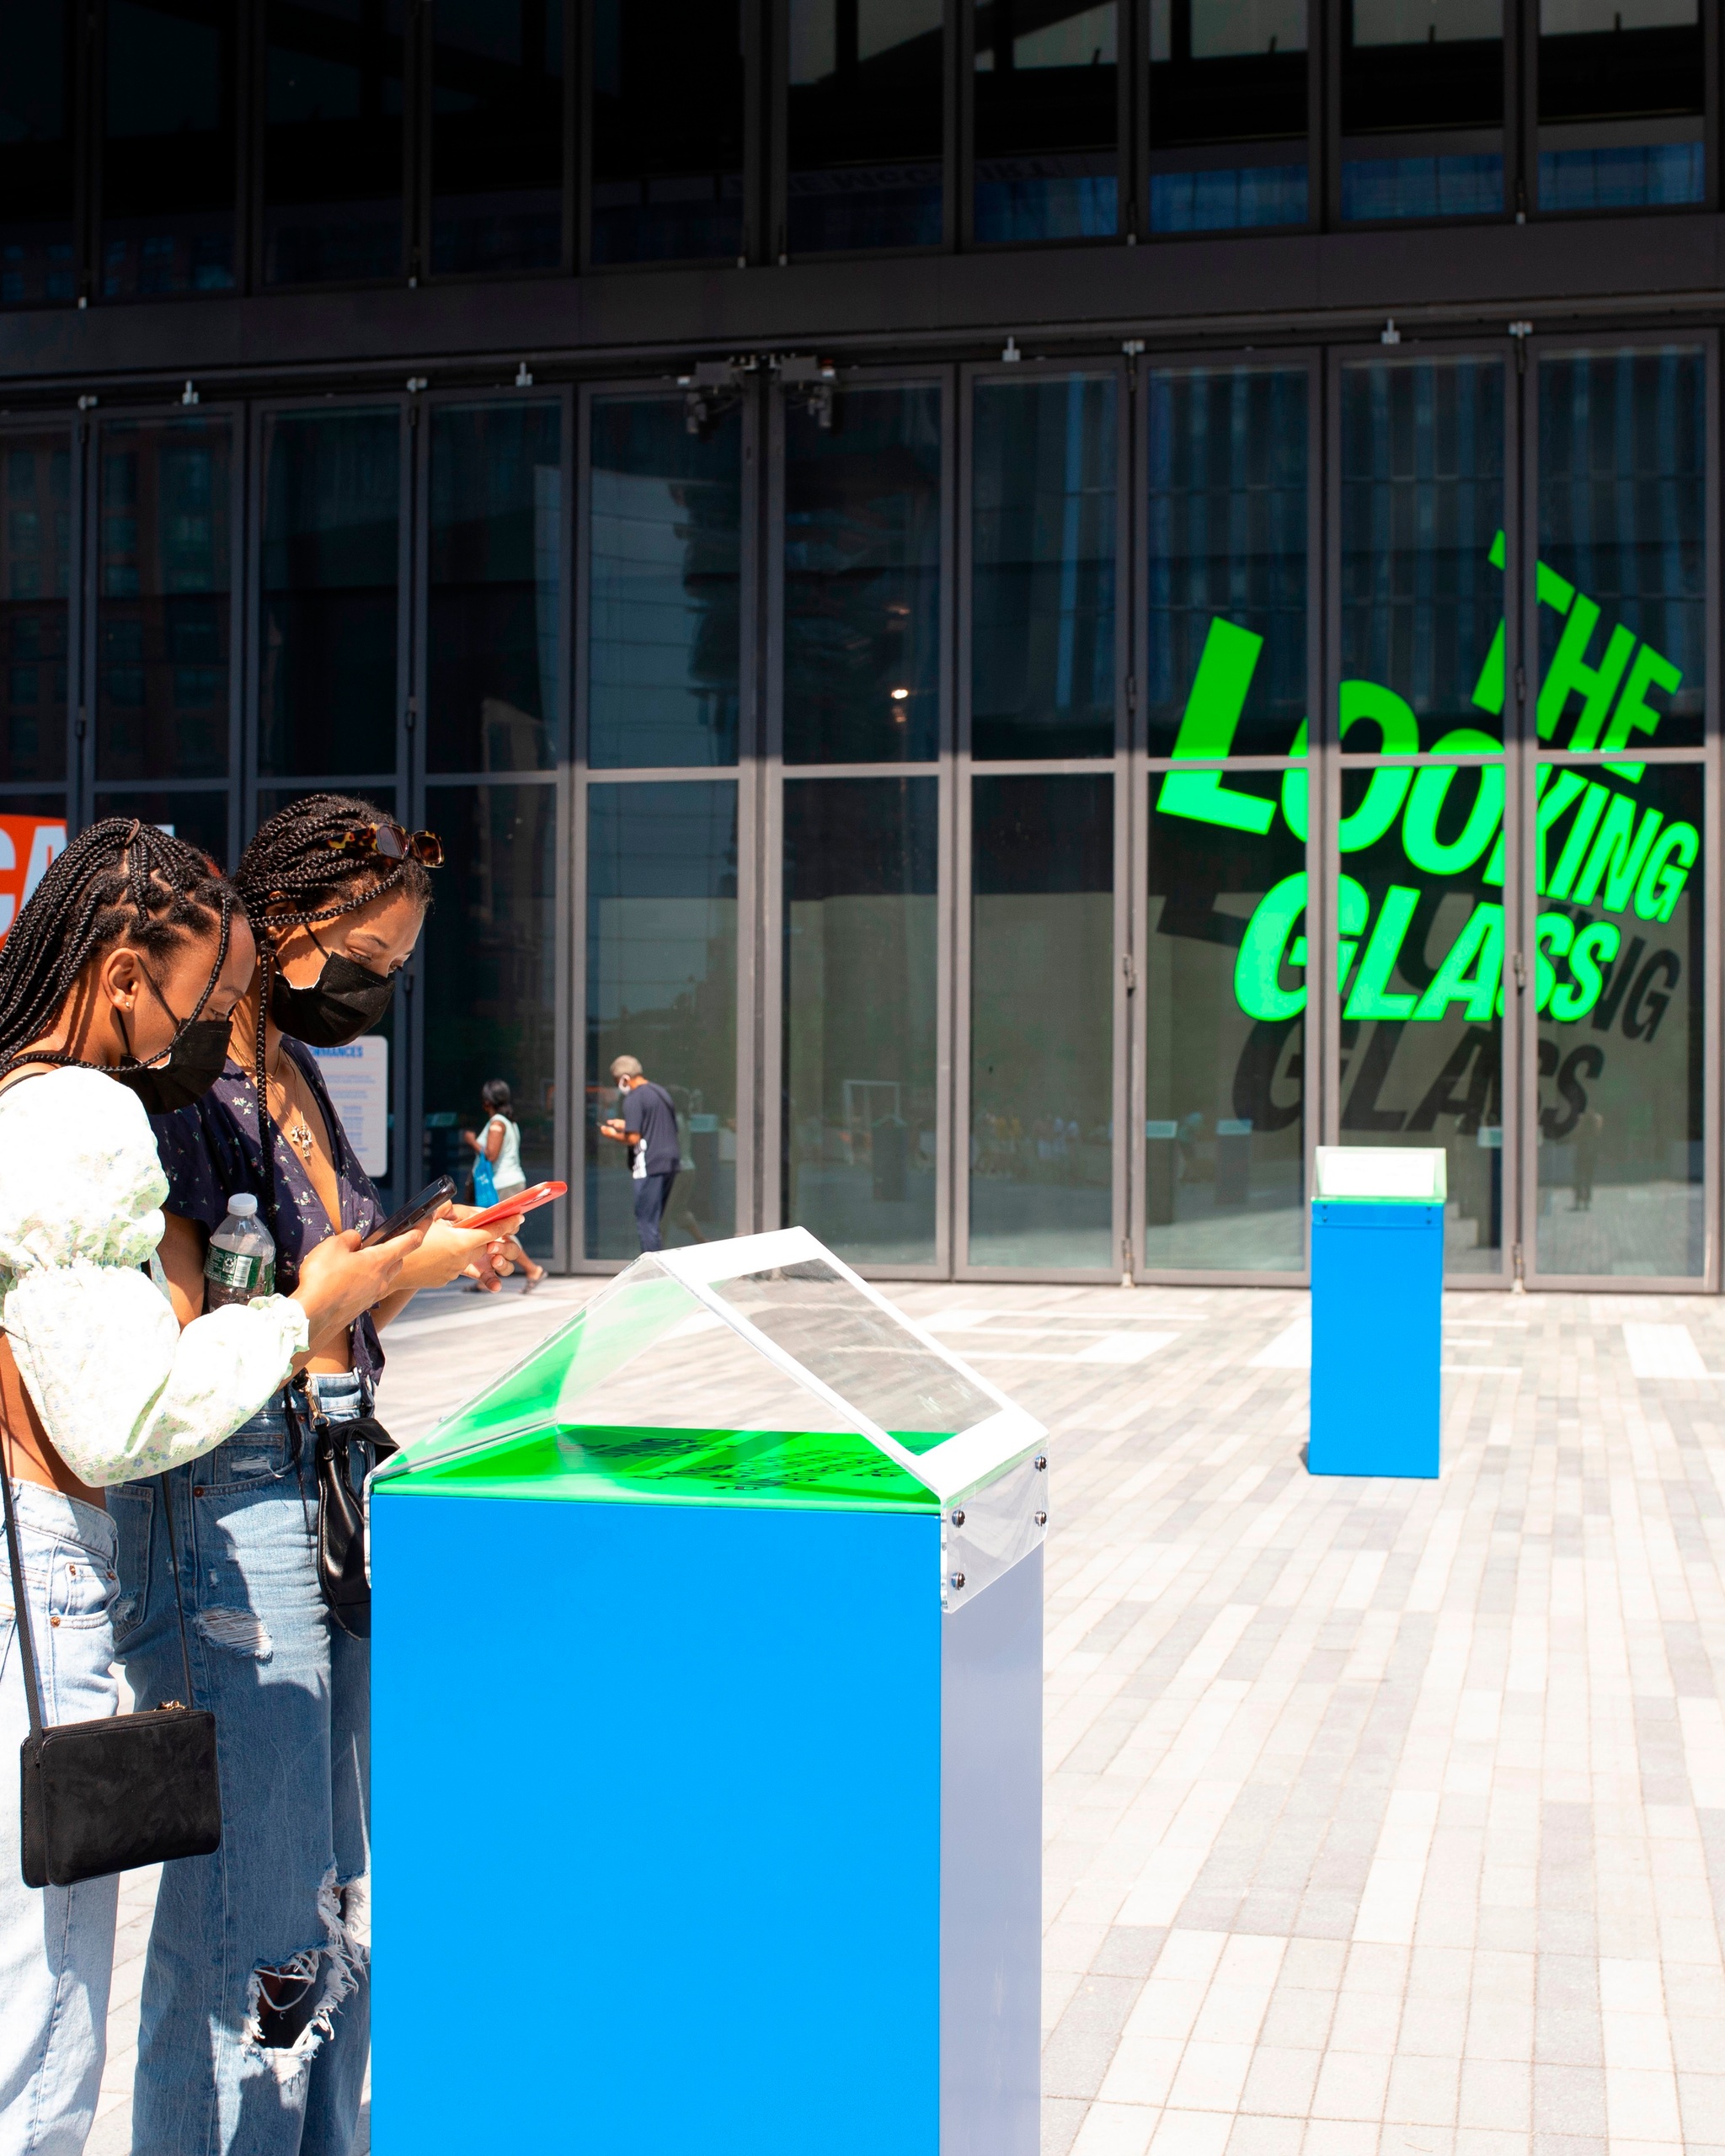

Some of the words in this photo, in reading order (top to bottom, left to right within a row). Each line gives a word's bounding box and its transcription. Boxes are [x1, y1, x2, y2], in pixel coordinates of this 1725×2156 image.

[1156, 616, 1700, 924] LOOKING
[1471, 529, 1683, 784] THE
[1233, 871, 1621, 1022] GLASS
